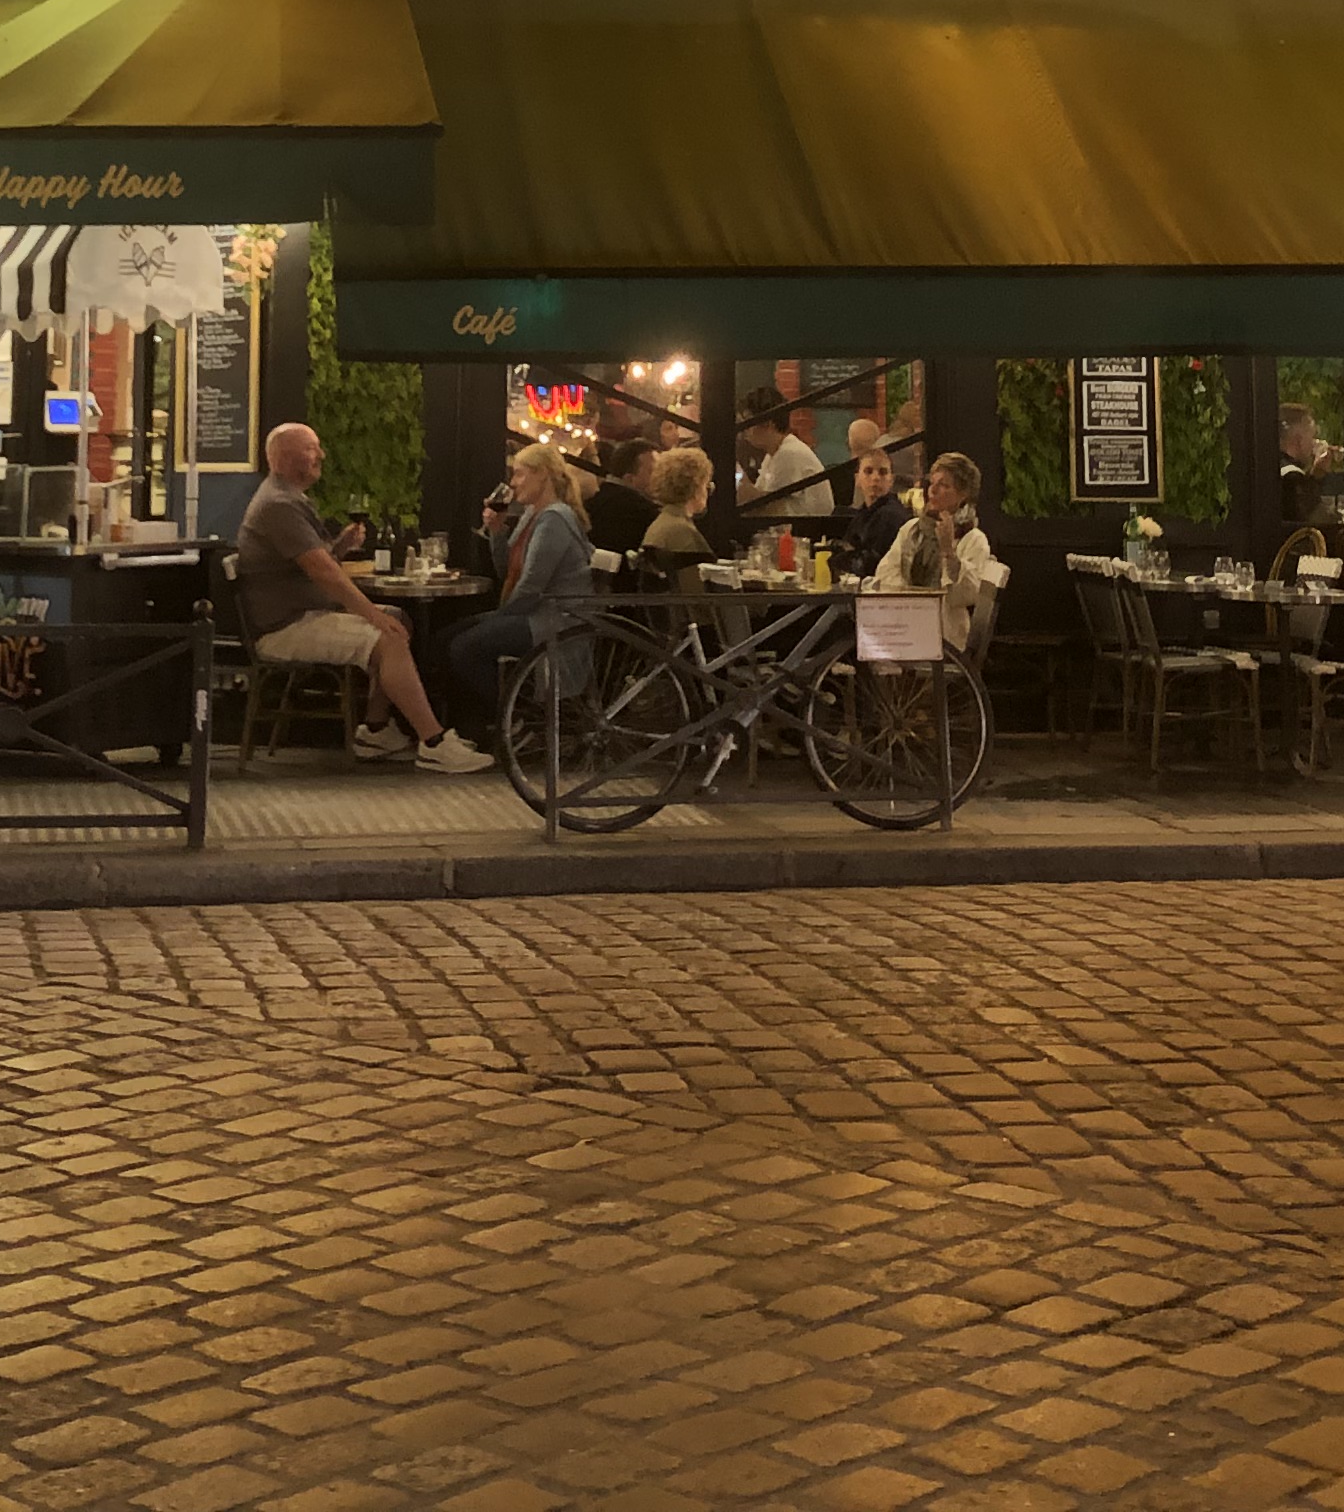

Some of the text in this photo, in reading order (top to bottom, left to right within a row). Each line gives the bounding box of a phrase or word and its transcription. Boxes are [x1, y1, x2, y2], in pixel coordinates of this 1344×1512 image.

[97, 163, 185, 199] Hour
[452, 304, 519, 345] Café
[1096, 364, 1134, 374] TAPAS
[1090, 400, 1139, 411] STEAKHOUSE
